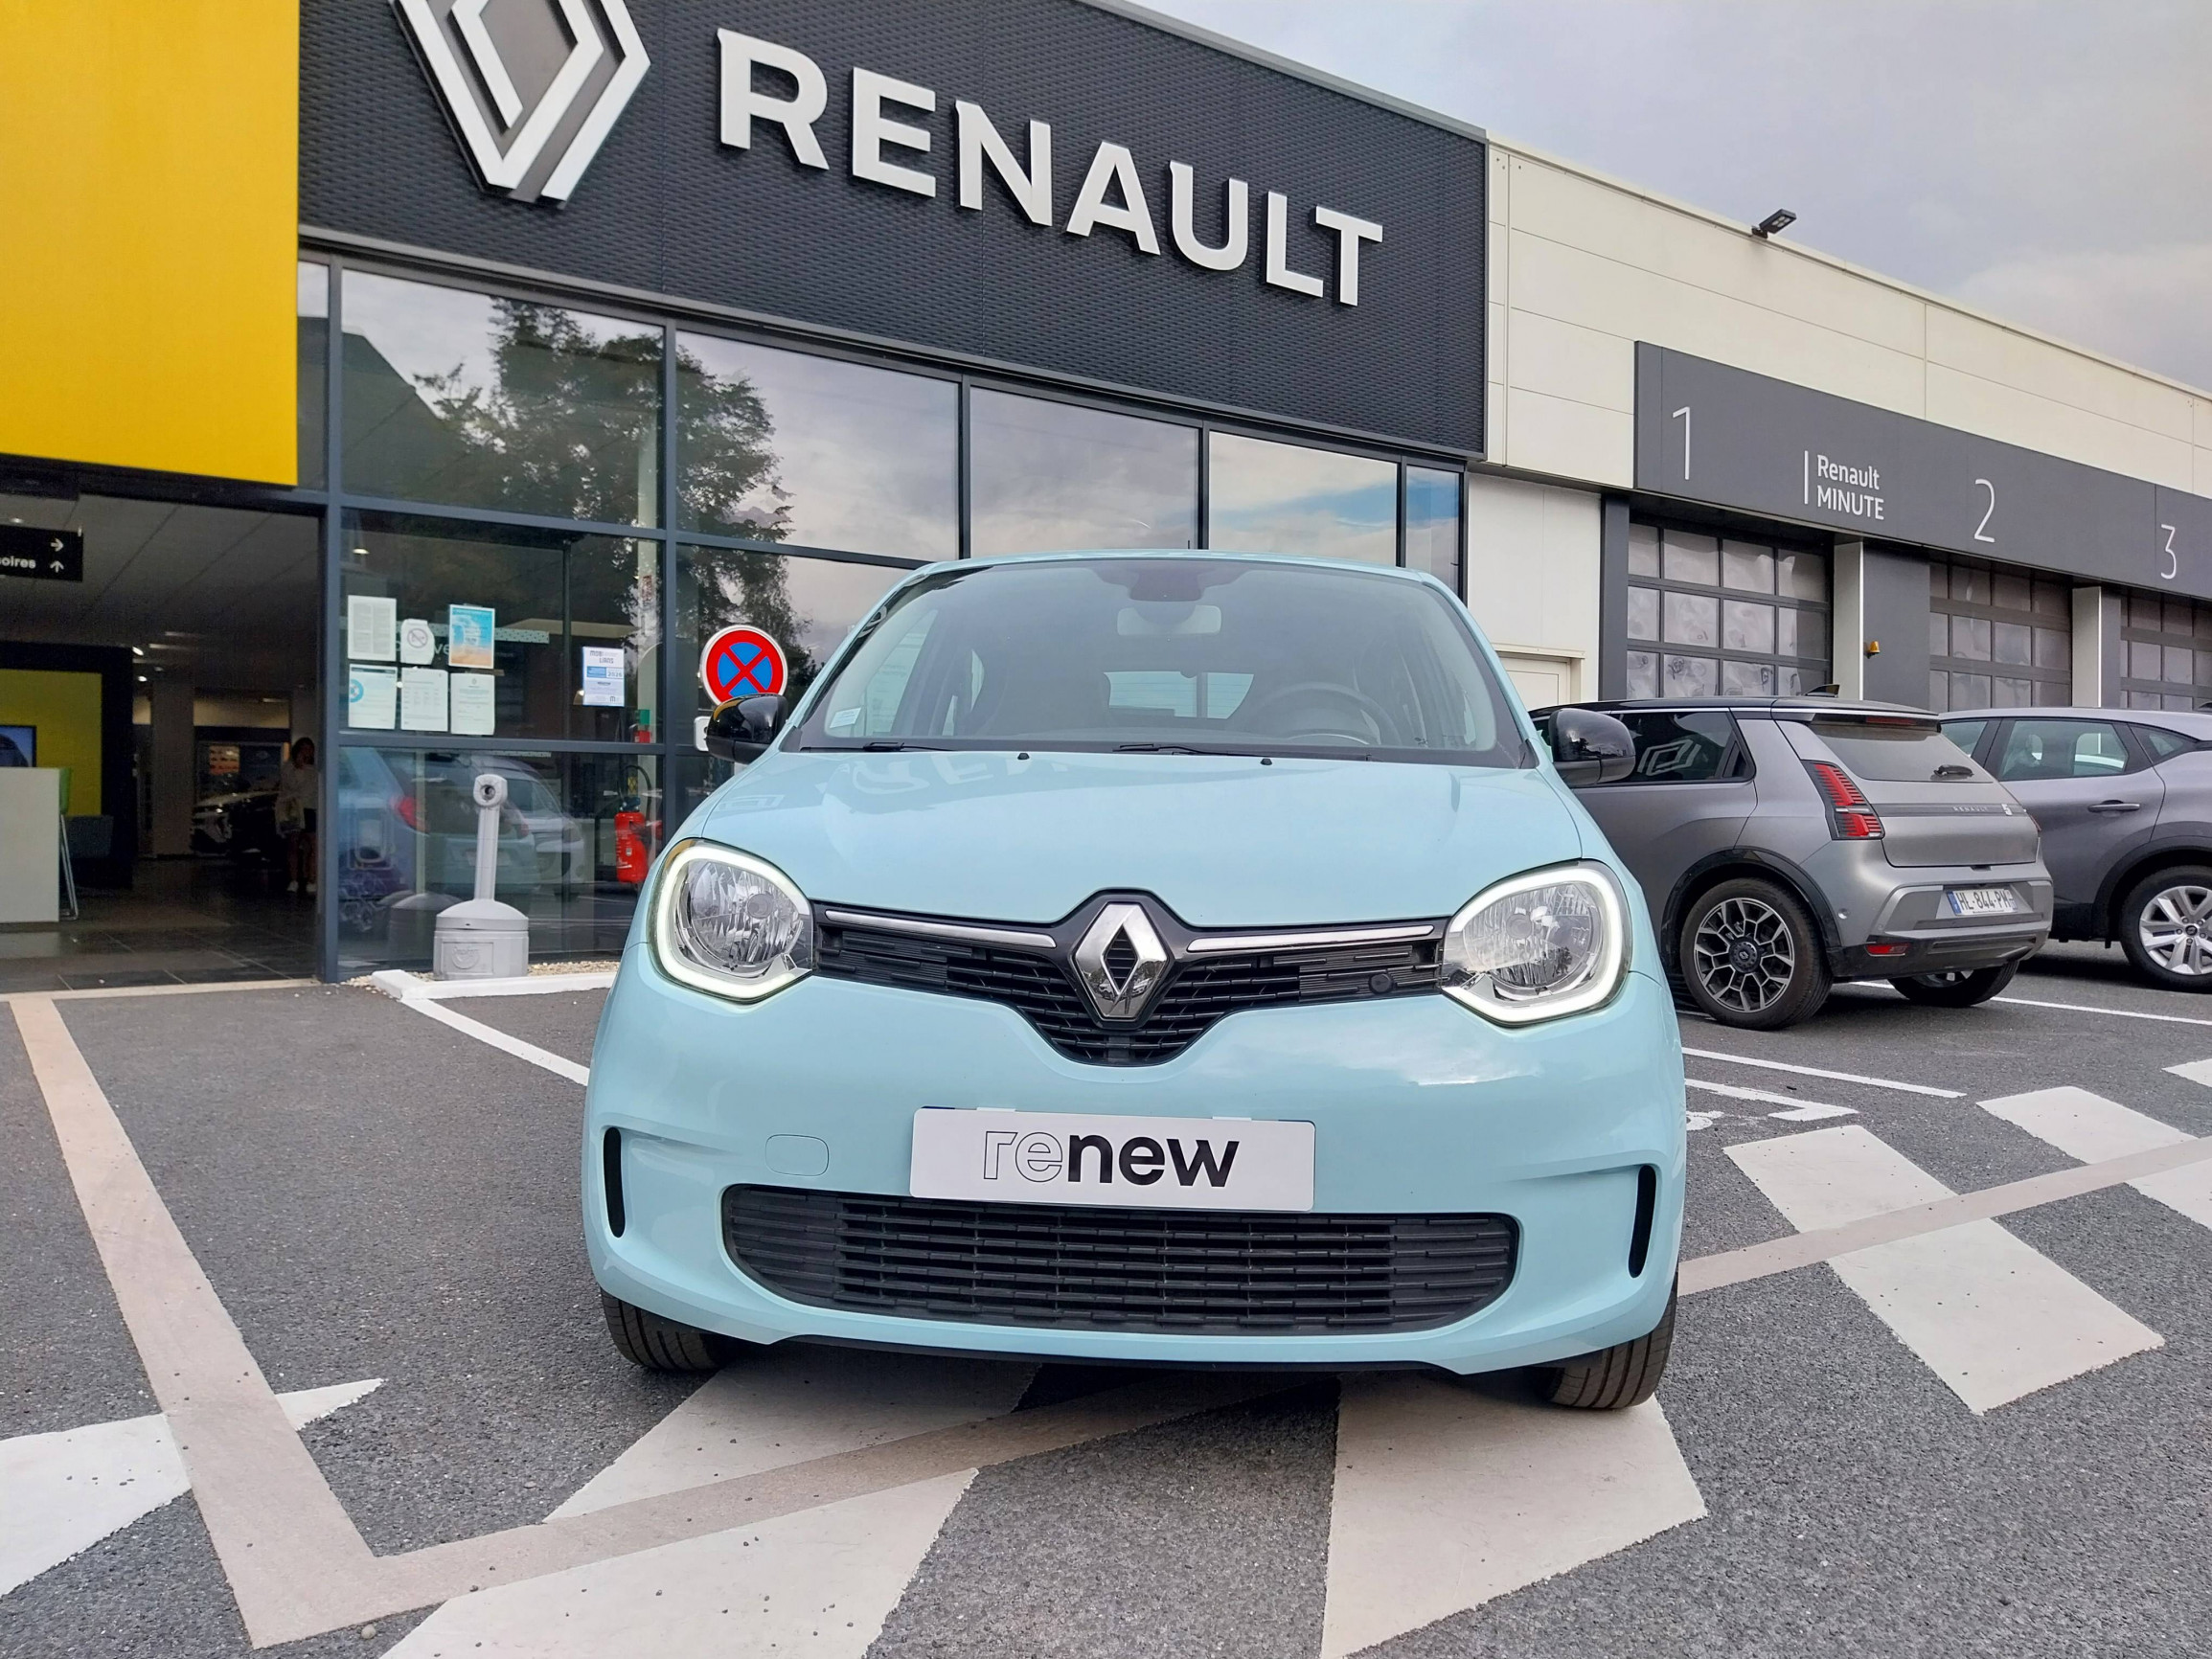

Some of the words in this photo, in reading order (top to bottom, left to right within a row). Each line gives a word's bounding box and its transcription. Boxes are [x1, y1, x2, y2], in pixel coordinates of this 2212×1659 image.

[718, 28, 1383, 307] RENAULT
[1672, 406, 1691, 480] 1
[1816, 454, 1881, 490] Renault
[1816, 485, 1884, 520] MINUTE
[1973, 478, 1995, 543] 2
[0, 556, 36, 569] oires
[2160, 523, 2178, 580] 3
[2001, 804, 2013, 816] 5
[983, 1130, 1240, 1188] renew
